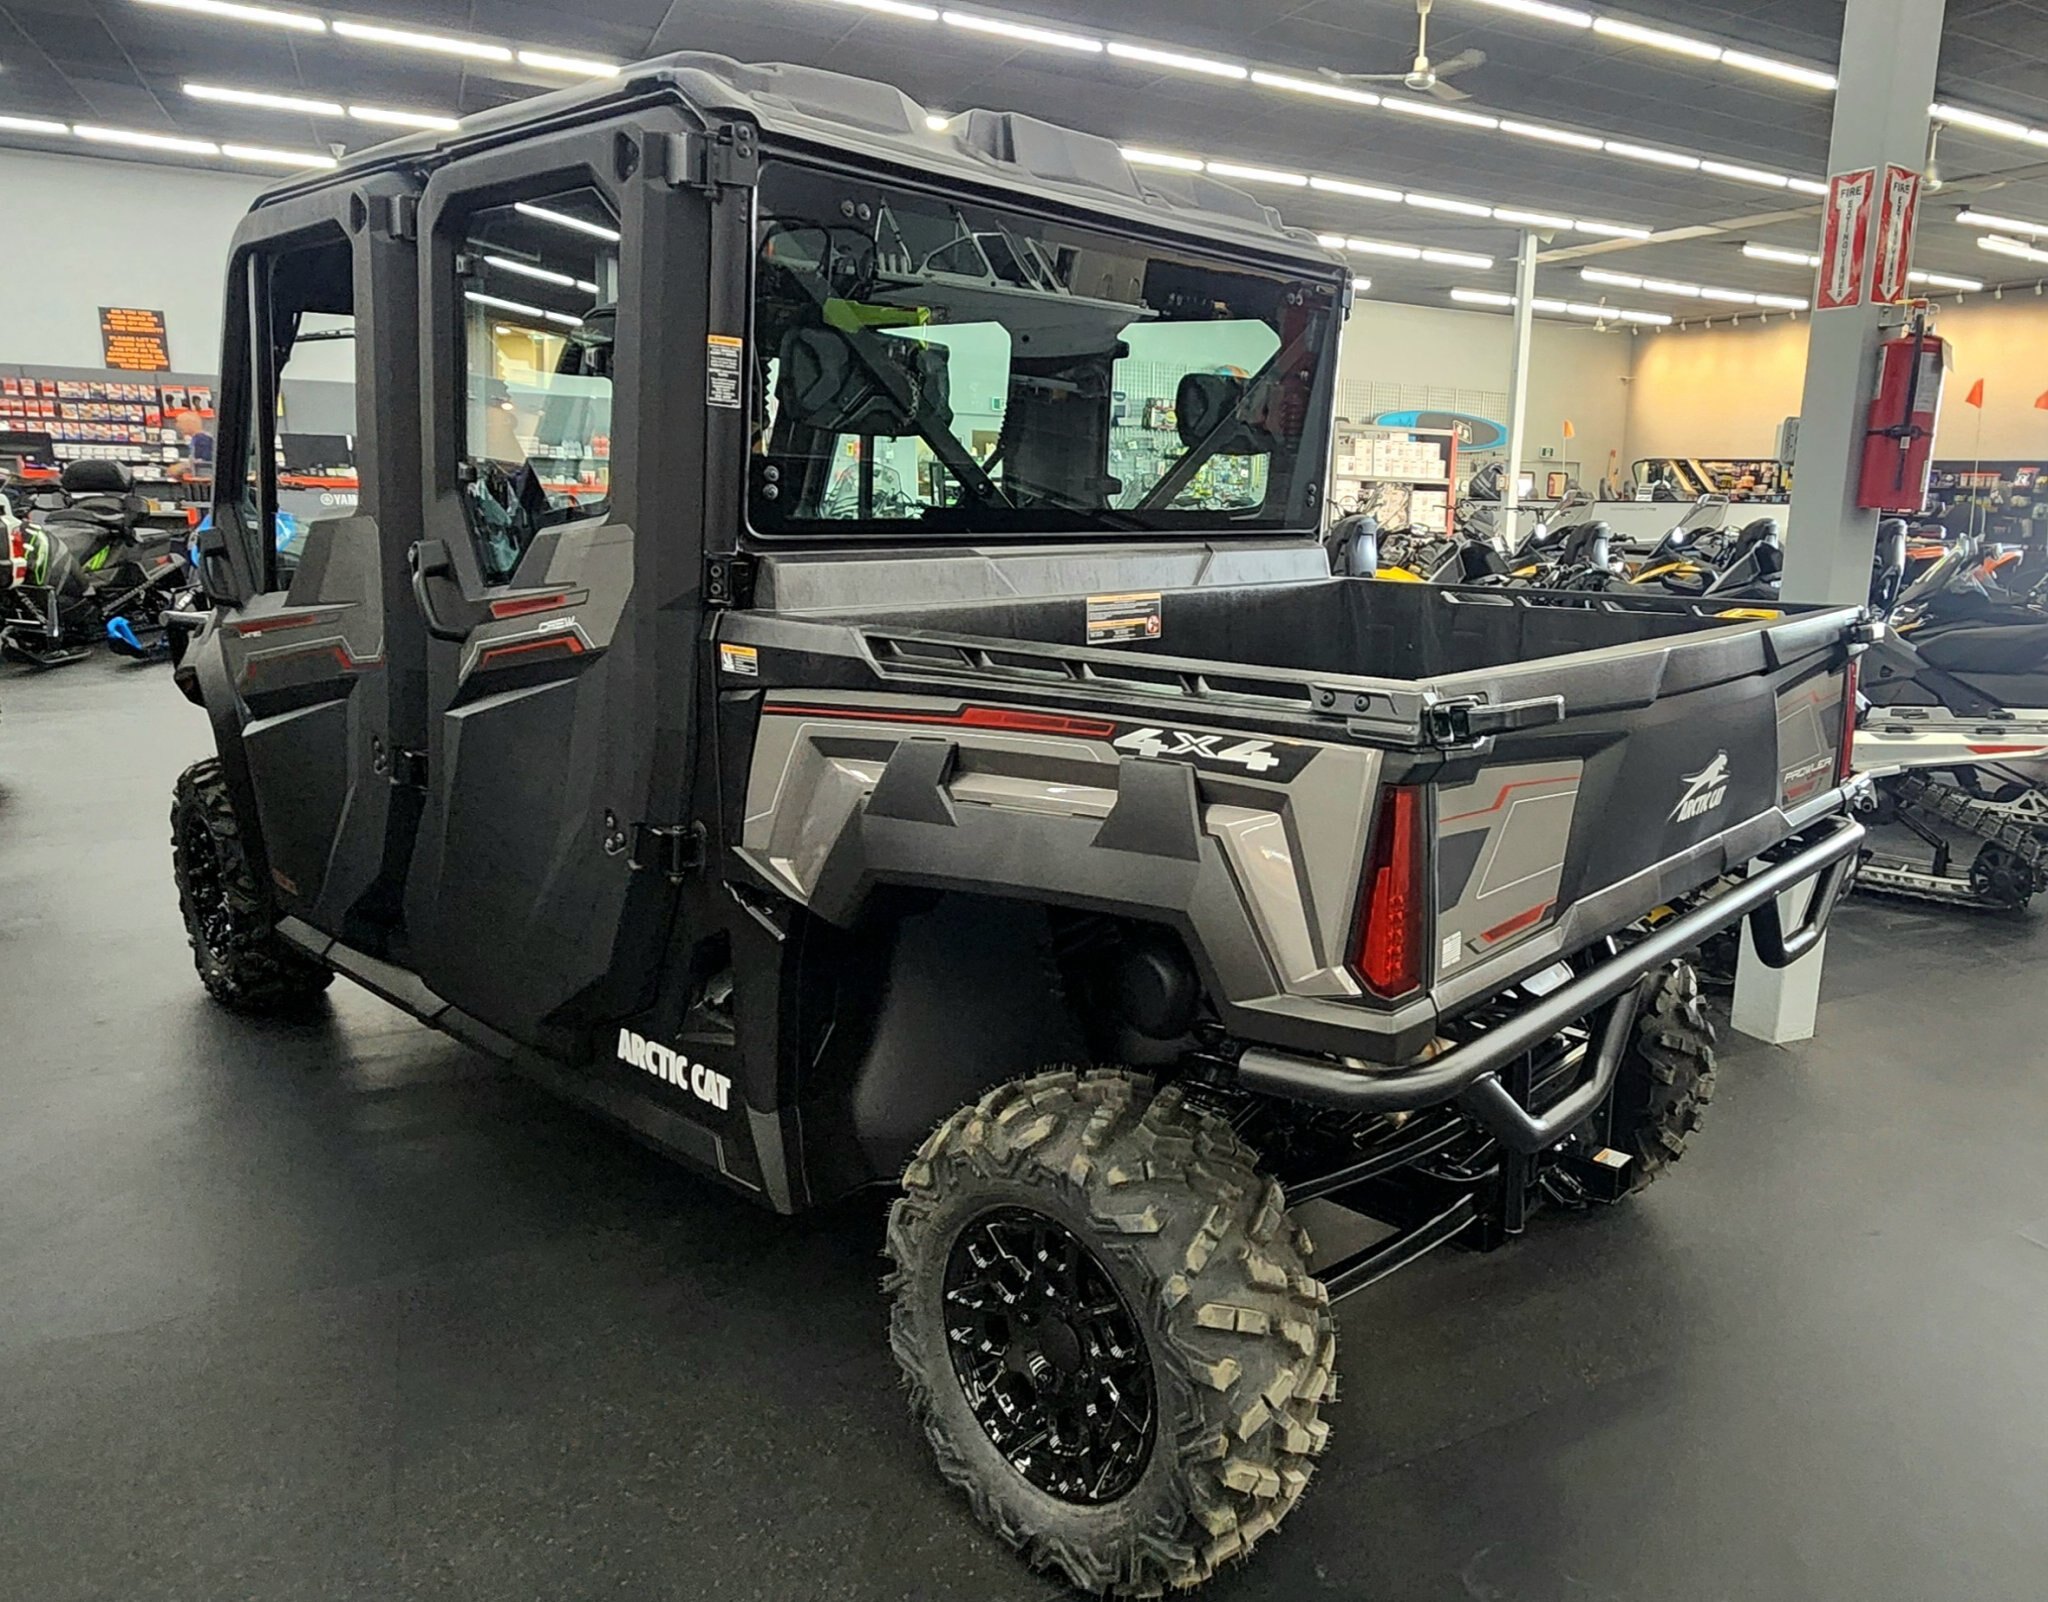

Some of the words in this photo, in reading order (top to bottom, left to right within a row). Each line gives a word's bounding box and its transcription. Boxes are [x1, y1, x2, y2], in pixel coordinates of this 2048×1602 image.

[1840, 185, 1863, 199] FIRE
[1783, 756, 1833, 784] PROWLER
[1676, 791, 1712, 823] ARCTIC
[1708, 785, 1727, 809] CAT
[617, 1027, 688, 1091] ARCTIC
[690, 1063, 732, 1111] CAT
